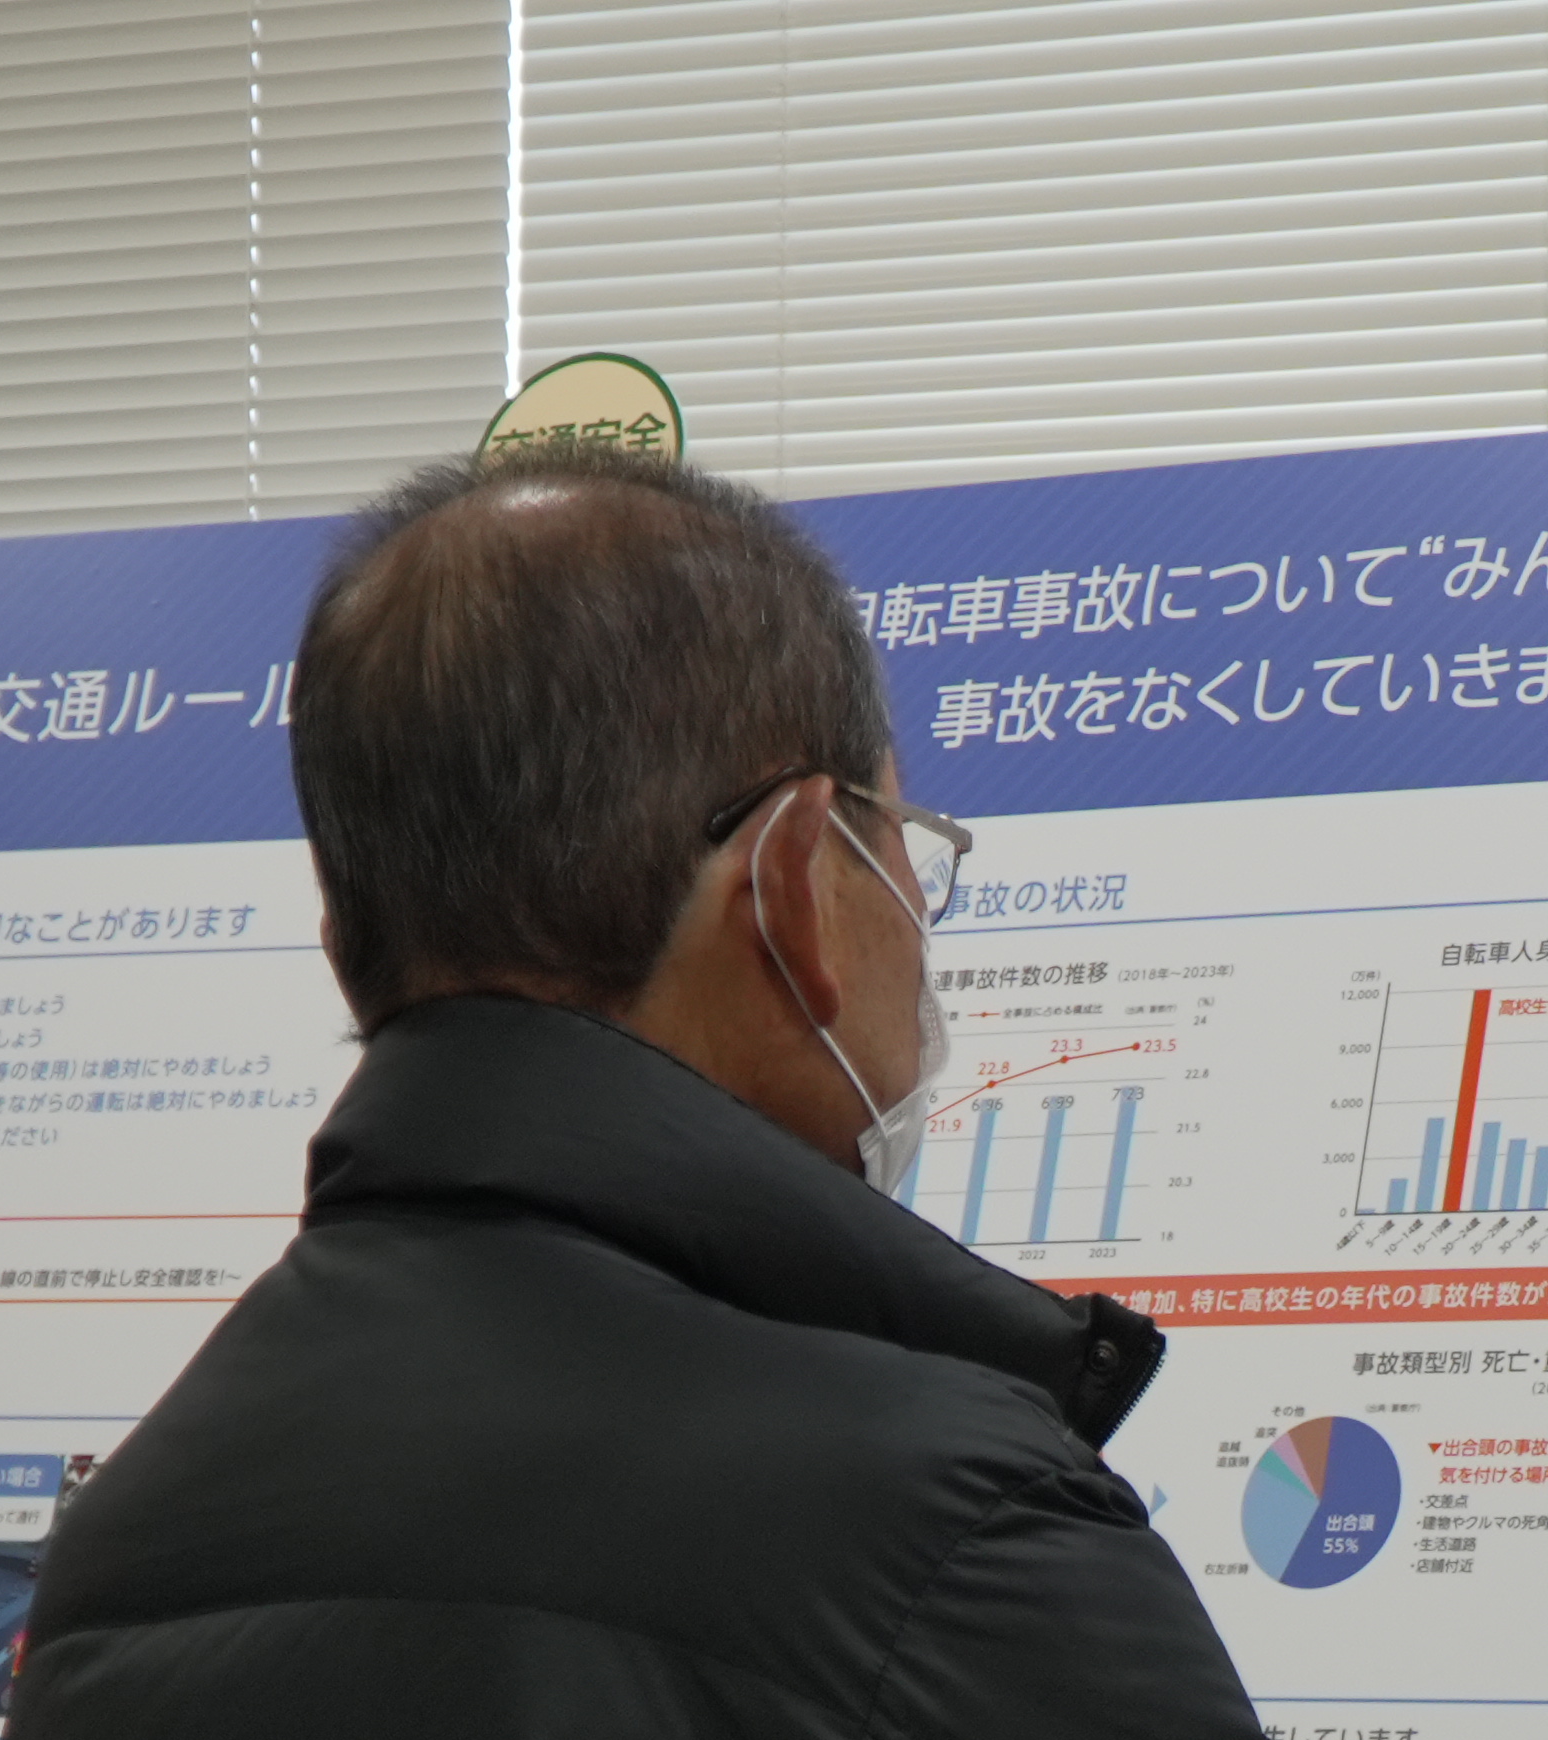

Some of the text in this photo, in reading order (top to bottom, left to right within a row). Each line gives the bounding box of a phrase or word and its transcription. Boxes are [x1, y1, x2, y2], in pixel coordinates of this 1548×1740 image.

[946, 873, 1126, 920] 事故の状況
[929, 961, 1108, 991] 連事故件数の推移
[1194, 1015, 1207, 1025] 24
[1051, 1039, 1083, 1052] 23.3
[1143, 1039, 1177, 1052] 23.5
[977, 1062, 1010, 1075] 22.8
[1185, 1069, 1209, 1079] 22.8
[1111, 1086, 1145, 1101] 7.23
[971, 1097, 1004, 1111] 6.96
[1041, 1096, 1075, 1110] 6.99
[928, 1119, 961, 1133] 21.9
[1176, 1123, 1200, 1134] 21.5
[1167, 1177, 1192, 1187] 20.3
[1160, 1232, 1174, 1242] 18
[1018, 1250, 1046, 1260] 2022
[1089, 1248, 1117, 1258] 2023
[1353, 1351, 1473, 1377] 事故類型別
[1272, 1406, 1305, 1417] その他
[1325, 1514, 1375, 1532] 出合頭
[1322, 1538, 1359, 1553] 55%
